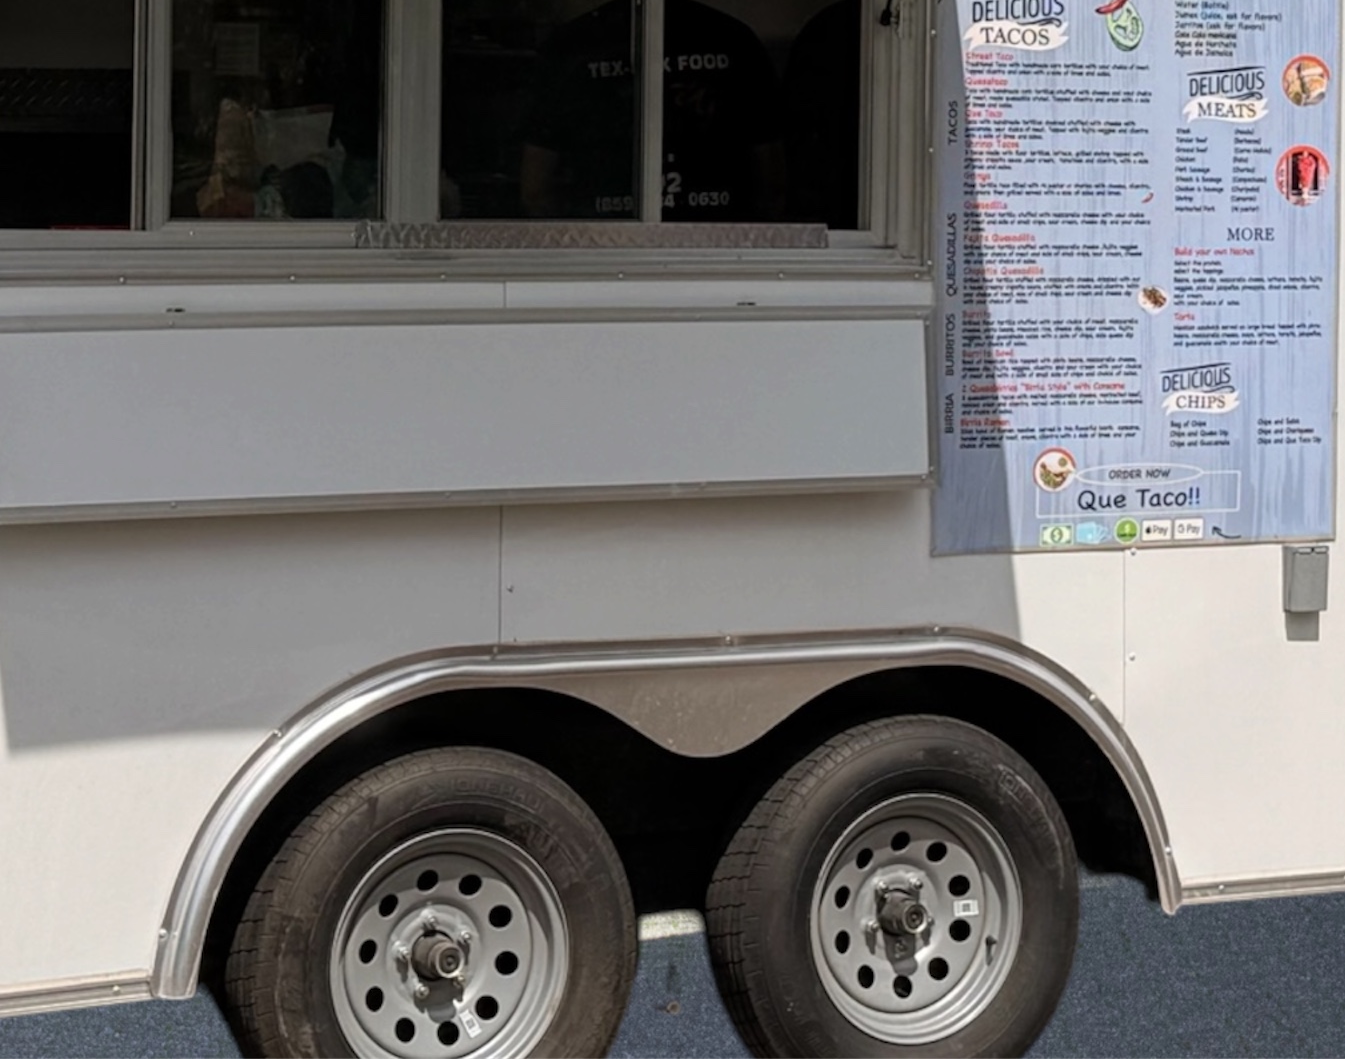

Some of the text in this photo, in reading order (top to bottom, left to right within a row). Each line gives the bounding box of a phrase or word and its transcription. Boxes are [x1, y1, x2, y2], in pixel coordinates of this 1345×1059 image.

[1175, 1, 1199, 9] Water
[980, 27, 1050, 46] TACOS
[677, 53, 730, 72] FOOD
[996, 52, 1014, 61] Taco
[1189, 71, 1265, 97] DELICIOUS
[985, 109, 1003, 118] Taco
[1197, 102, 1256, 118] MEATS
[948, 101, 958, 145] TACOS
[687, 191, 730, 207] 0630
[991, 234, 1036, 243] Quesadilla
[1227, 227, 1275, 241] MORE
[946, 213, 957, 297] QUESADILLAS
[1195, 249, 1211, 258] your
[1001, 267, 1044, 276] Quesadilla
[945, 313, 956, 376] BURRITOS
[1074, 382, 1091, 390] with
[1162, 367, 1231, 393] DELICIOUS
[1176, 395, 1226, 409] CHIPS
[944, 393, 954, 434] BIRRIA
[1191, 420, 1206, 429] Chips
[1257, 418, 1272, 426] Chips
[1170, 430, 1185, 438] Chips
[1257, 427, 1272, 435] Chips
[1170, 439, 1185, 448] Chips
[1187, 439, 1197, 447] and
[1257, 436, 1272, 445] Chips
[1274, 436, 1284, 444] and
[1108, 468, 1172, 480] ORDER NOW
[1077, 487, 1200, 512] Que Taco!!
[1153, 524, 1169, 536] Pay
[1187, 523, 1200, 536] Pay
